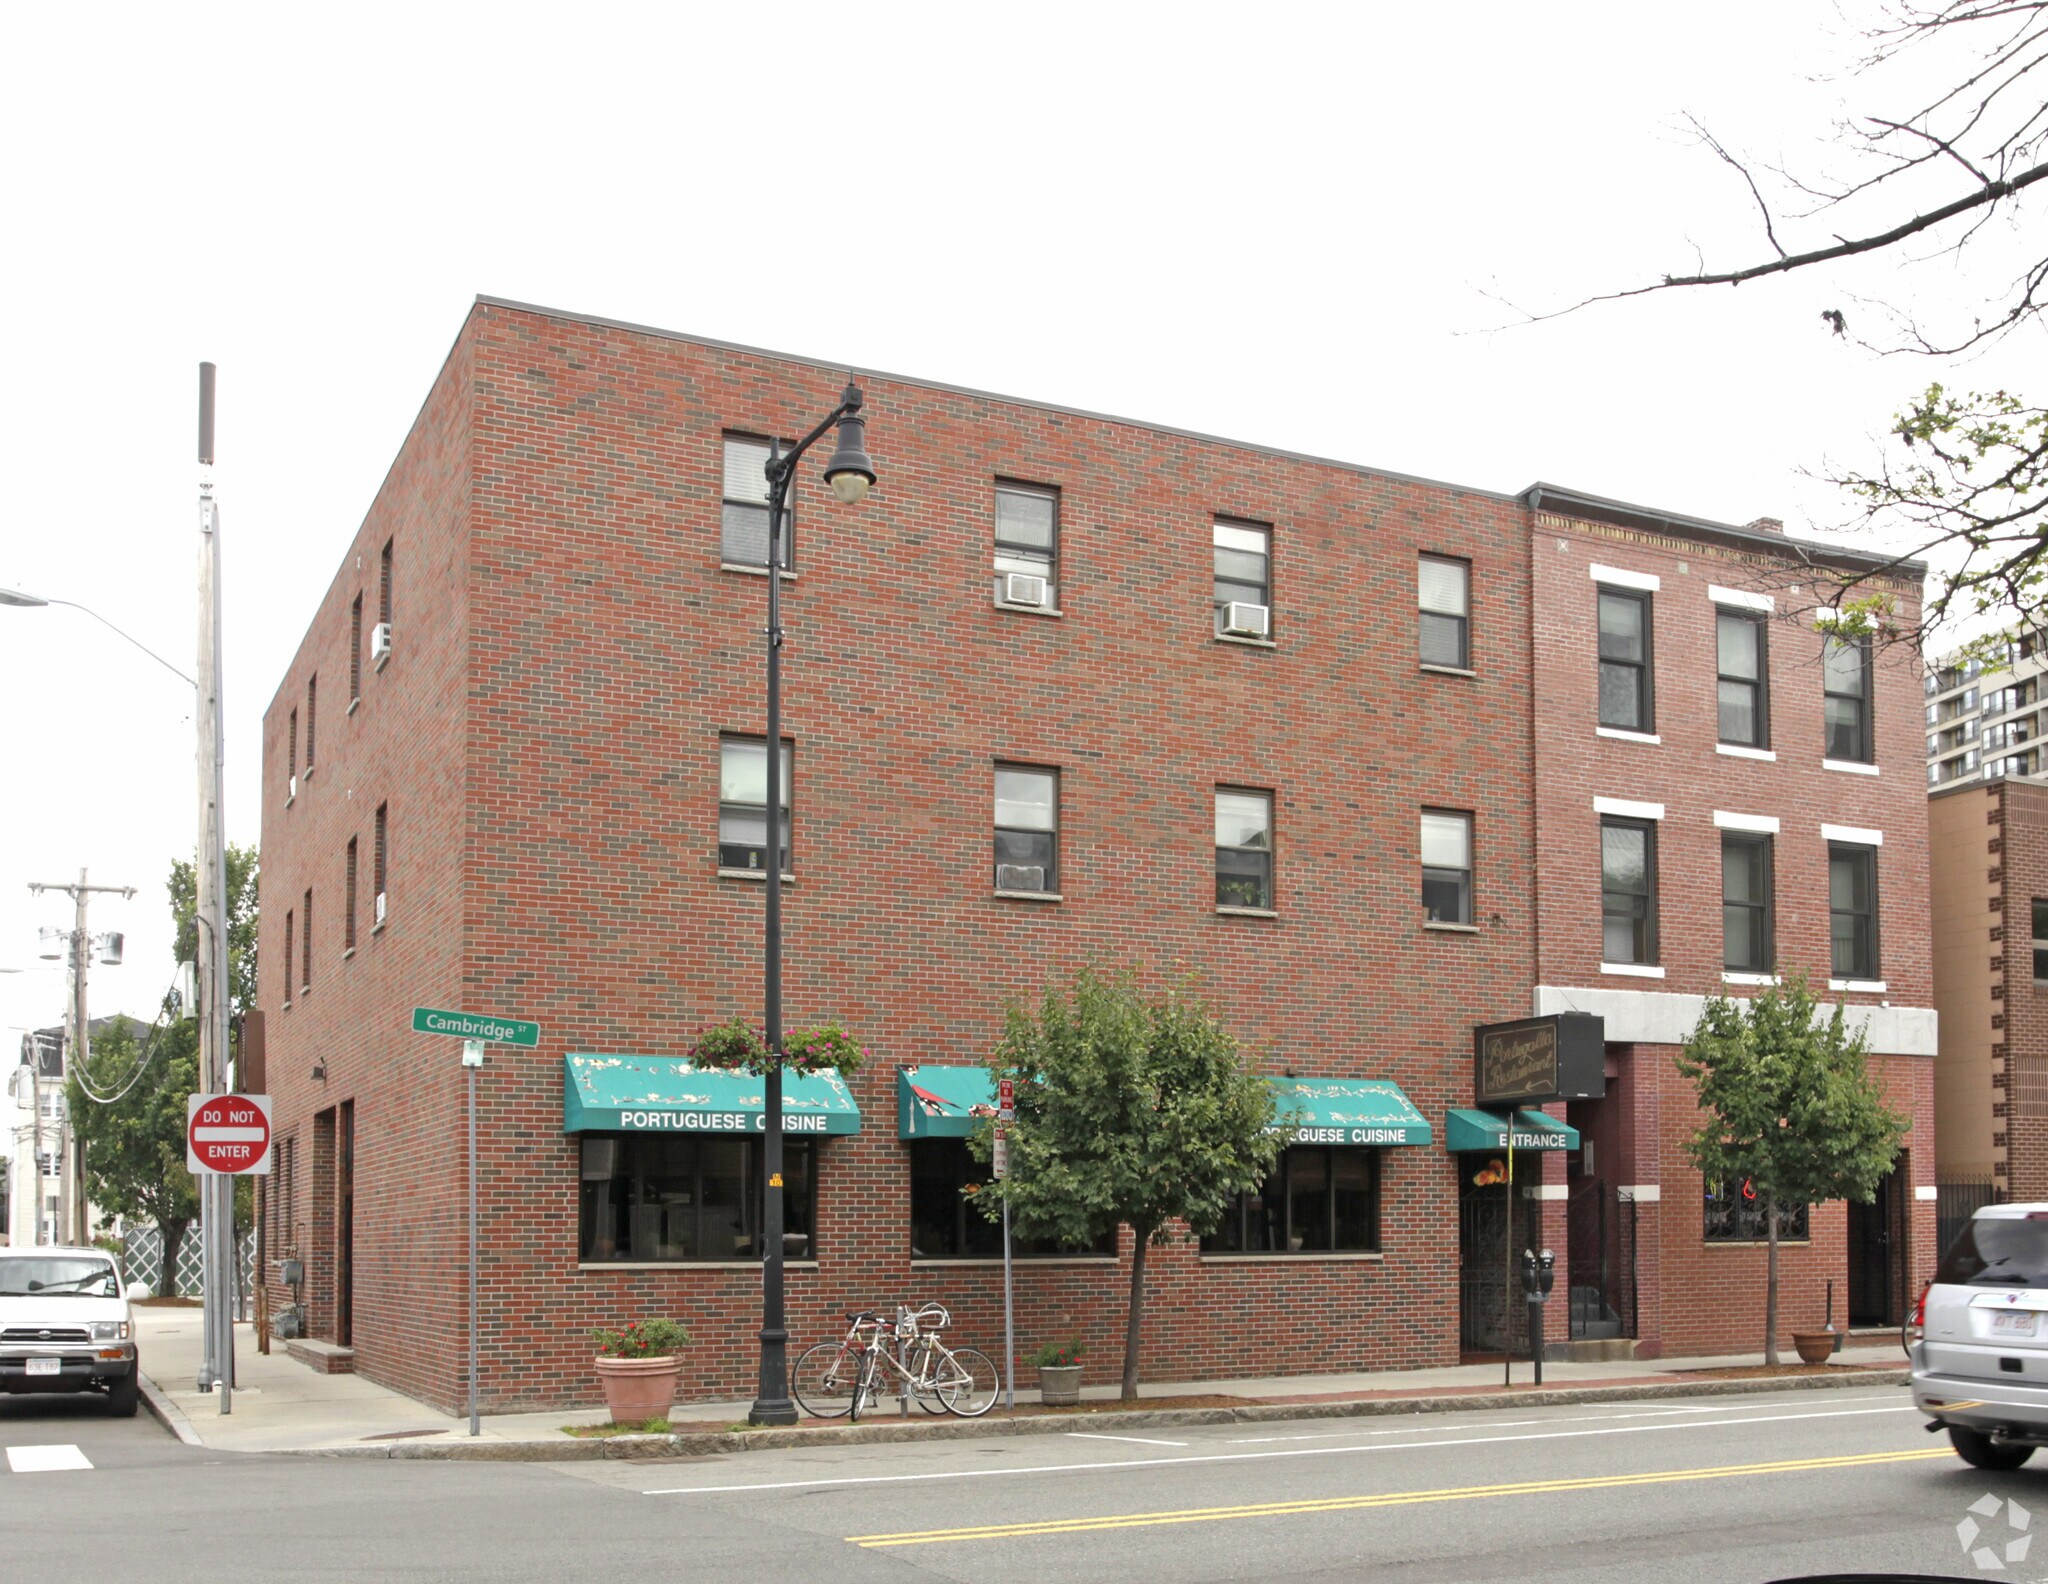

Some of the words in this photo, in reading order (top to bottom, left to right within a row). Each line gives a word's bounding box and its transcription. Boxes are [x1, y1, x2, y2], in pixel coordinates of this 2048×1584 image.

[426, 1014, 514, 1040] Cambridge
[518, 1025, 528, 1033] ST
[203, 1110, 222, 1123] DO
[229, 1110, 256, 1123] NOT
[620, 1111, 746, 1130] PORTUGUESE
[755, 1114, 827, 1131] CISINE
[1250, 1126, 1345, 1143] ORGUESE
[1351, 1128, 1407, 1143] CUISINE
[1499, 1133, 1567, 1147] ENTRANCE
[208, 1145, 250, 1158] ENTER
